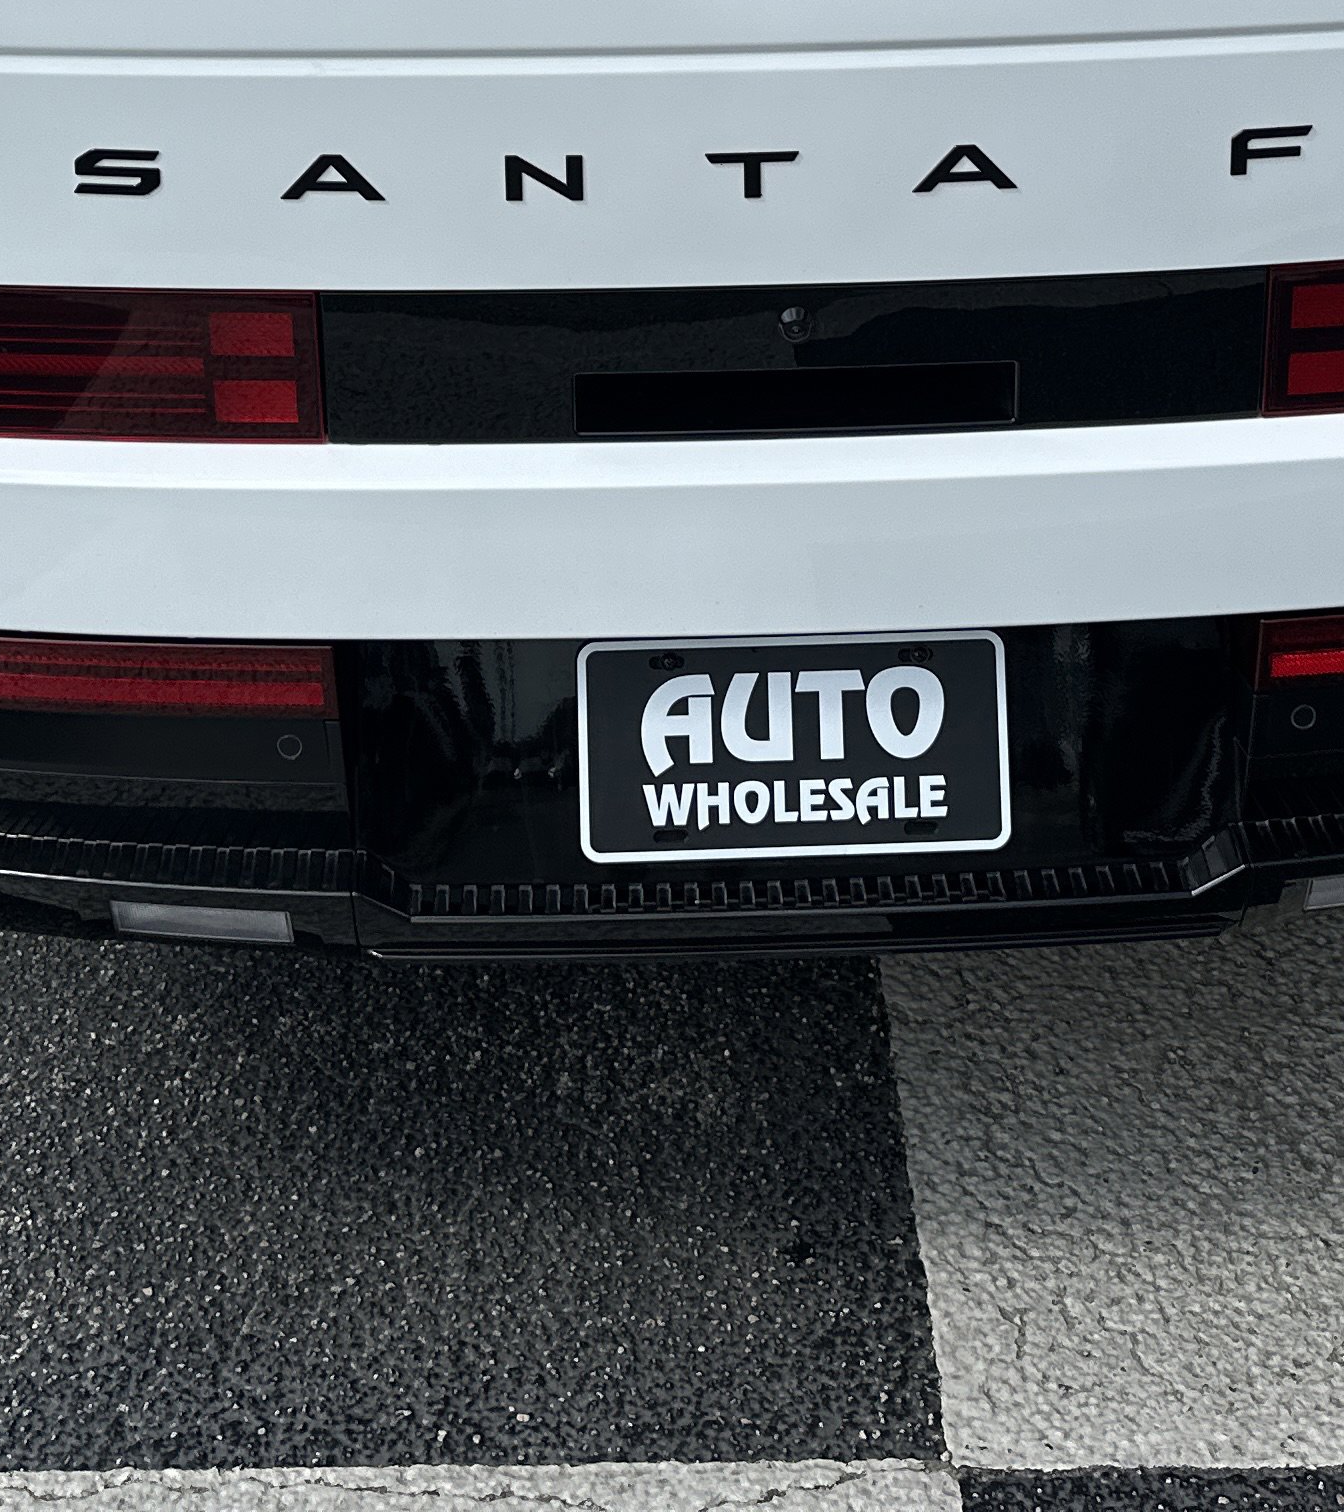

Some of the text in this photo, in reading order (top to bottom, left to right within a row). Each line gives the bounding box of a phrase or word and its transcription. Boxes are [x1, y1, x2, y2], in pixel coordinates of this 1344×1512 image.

[73, 144, 1019, 202] SANTA
[639, 665, 946, 778] AUTO
[641, 774, 949, 831] WHOLESALE
